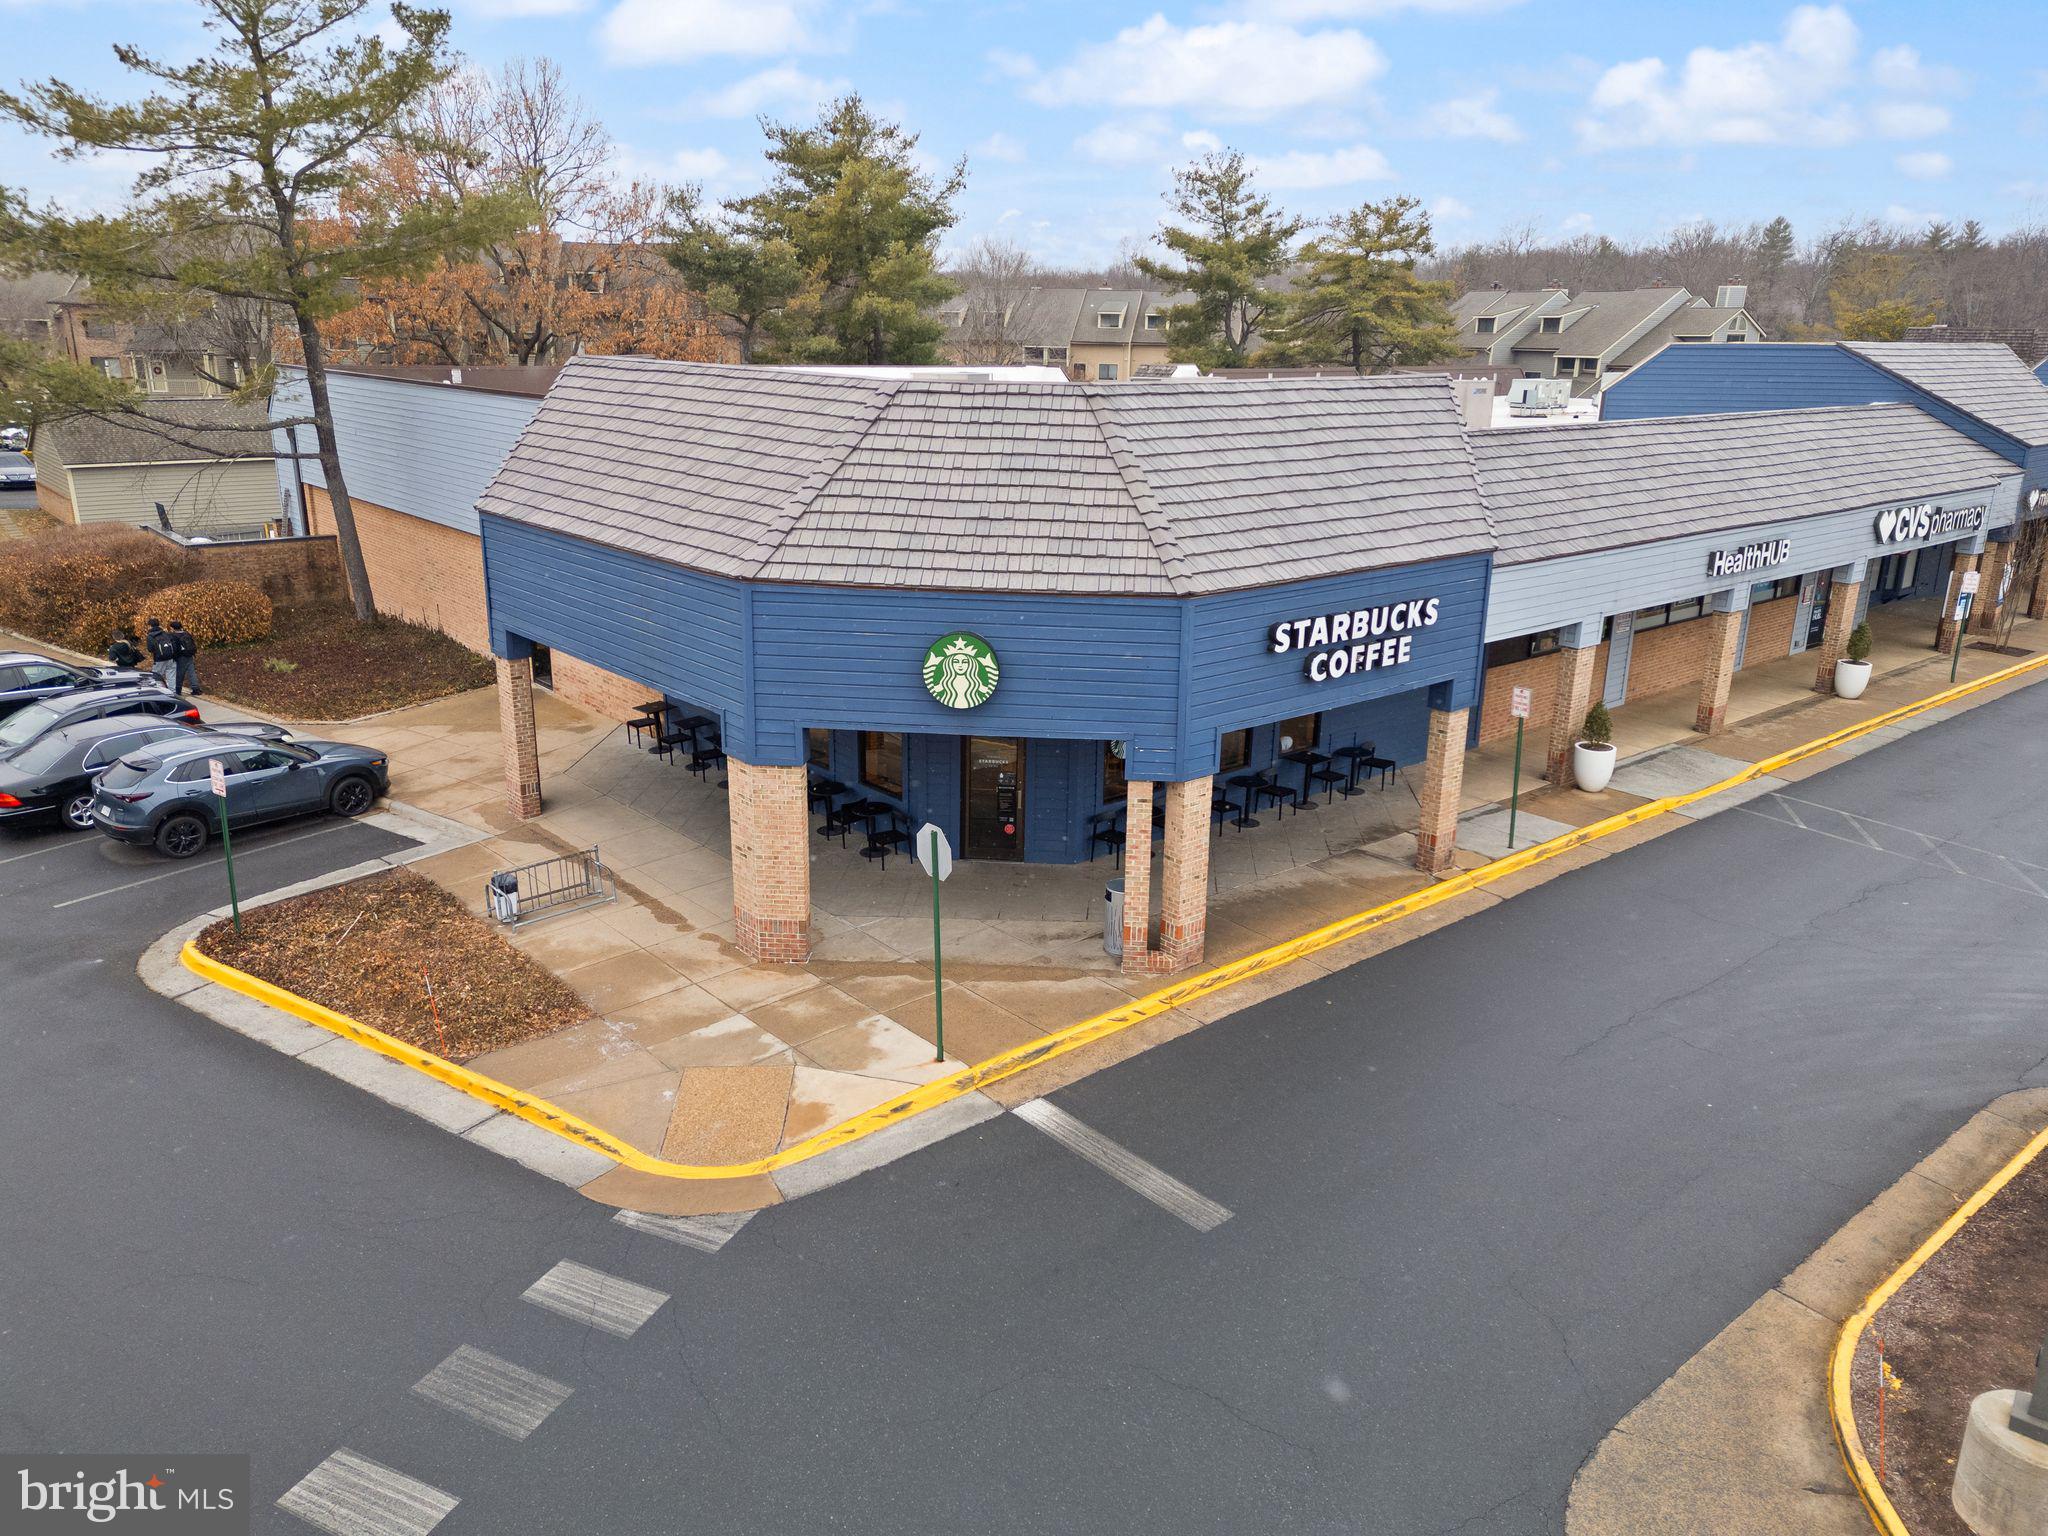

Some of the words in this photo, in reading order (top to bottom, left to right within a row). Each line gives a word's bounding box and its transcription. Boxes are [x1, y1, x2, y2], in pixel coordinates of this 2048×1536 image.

[1895, 504, 1931, 542] CVS
[1929, 506, 1987, 541] pharmacy
[1712, 539, 1791, 577] HealthHUB
[1274, 598, 1440, 653] STARBUCKS
[1310, 635, 1413, 682] COFFEE
